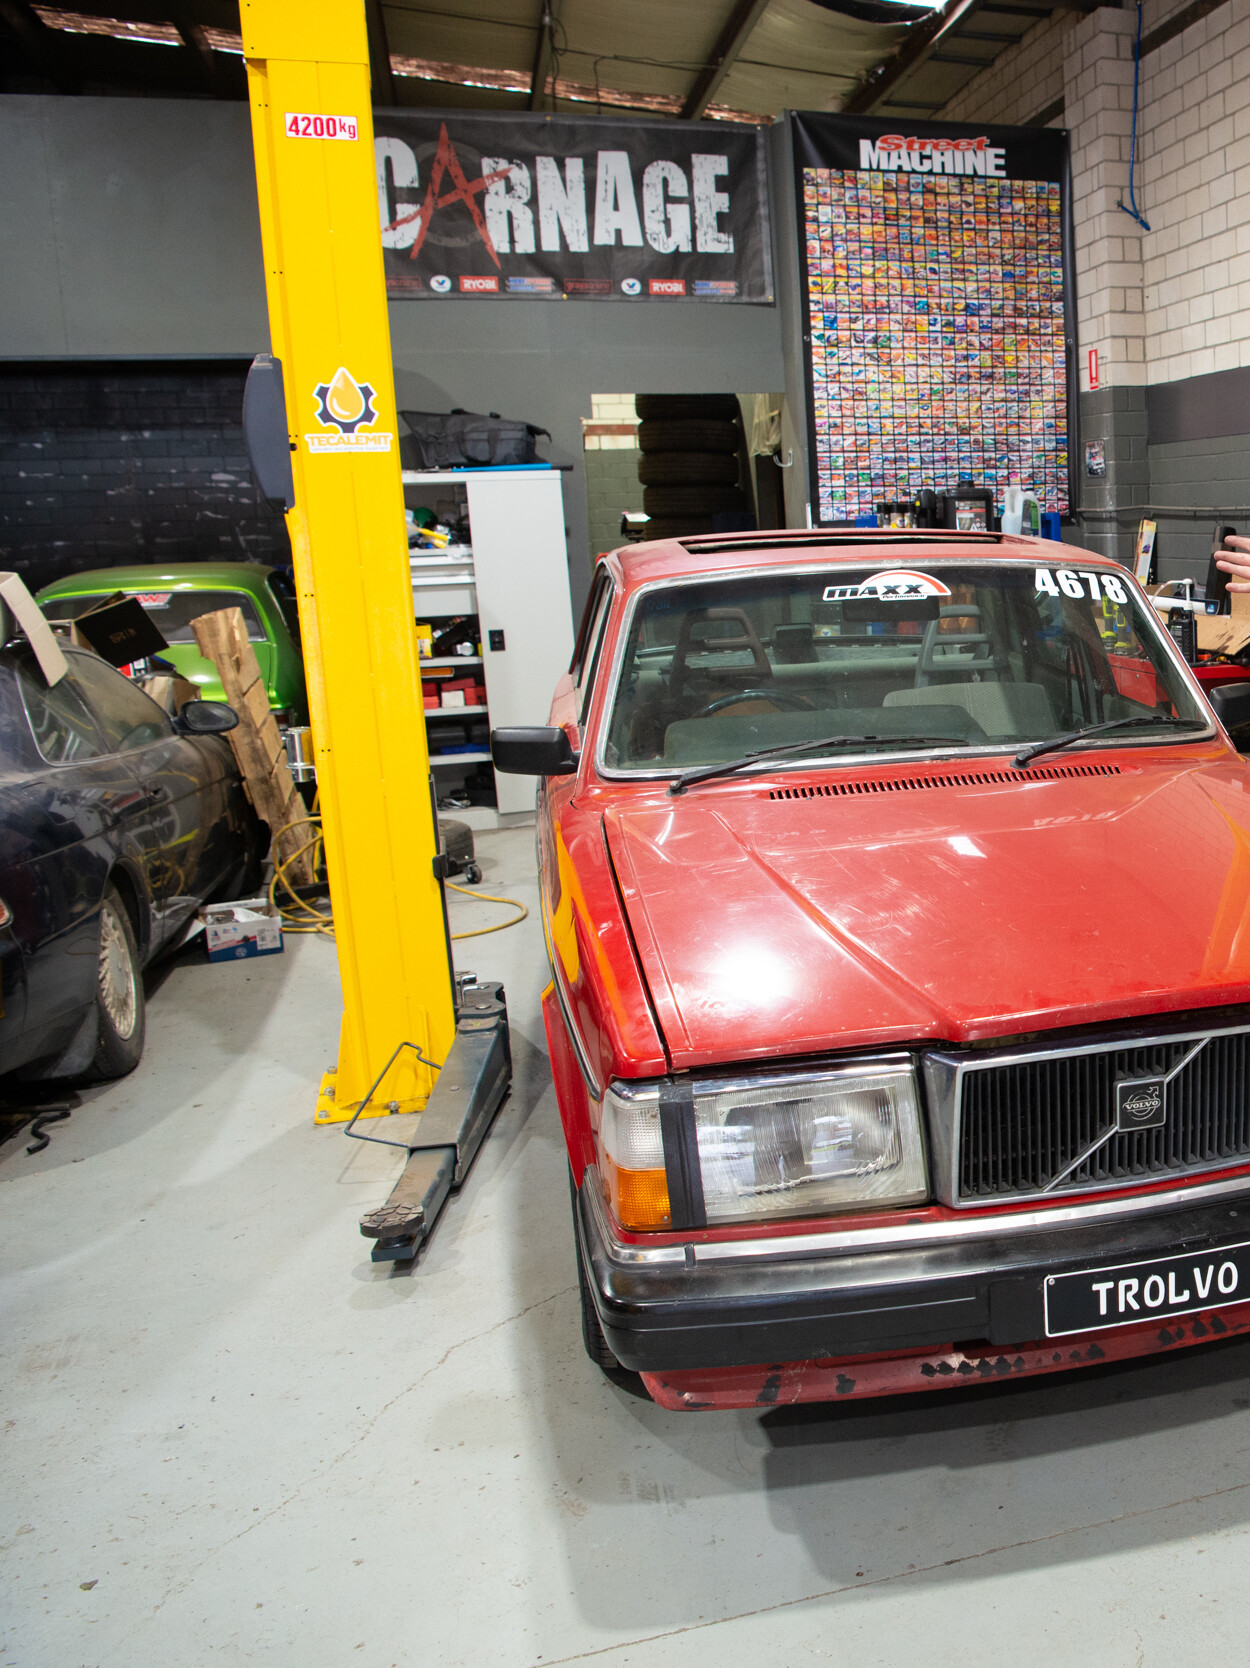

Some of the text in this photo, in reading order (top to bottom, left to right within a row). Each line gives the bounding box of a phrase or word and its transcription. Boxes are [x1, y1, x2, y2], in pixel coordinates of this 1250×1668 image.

[288, 115, 356, 139] 4200kg
[877, 134, 991, 152] Street
[859, 138, 1007, 178] MACHINE
[371, 121, 735, 270] CARNAGE
[462, 278, 497, 290] RYOBI
[652, 281, 684, 293] RYOBI
[307, 435, 390, 446] TECALEMIT
[1035, 568, 1128, 604] 4678
[1125, 1100, 1159, 1110] VOLVO
[1091, 1261, 1239, 1315] TROLVO
